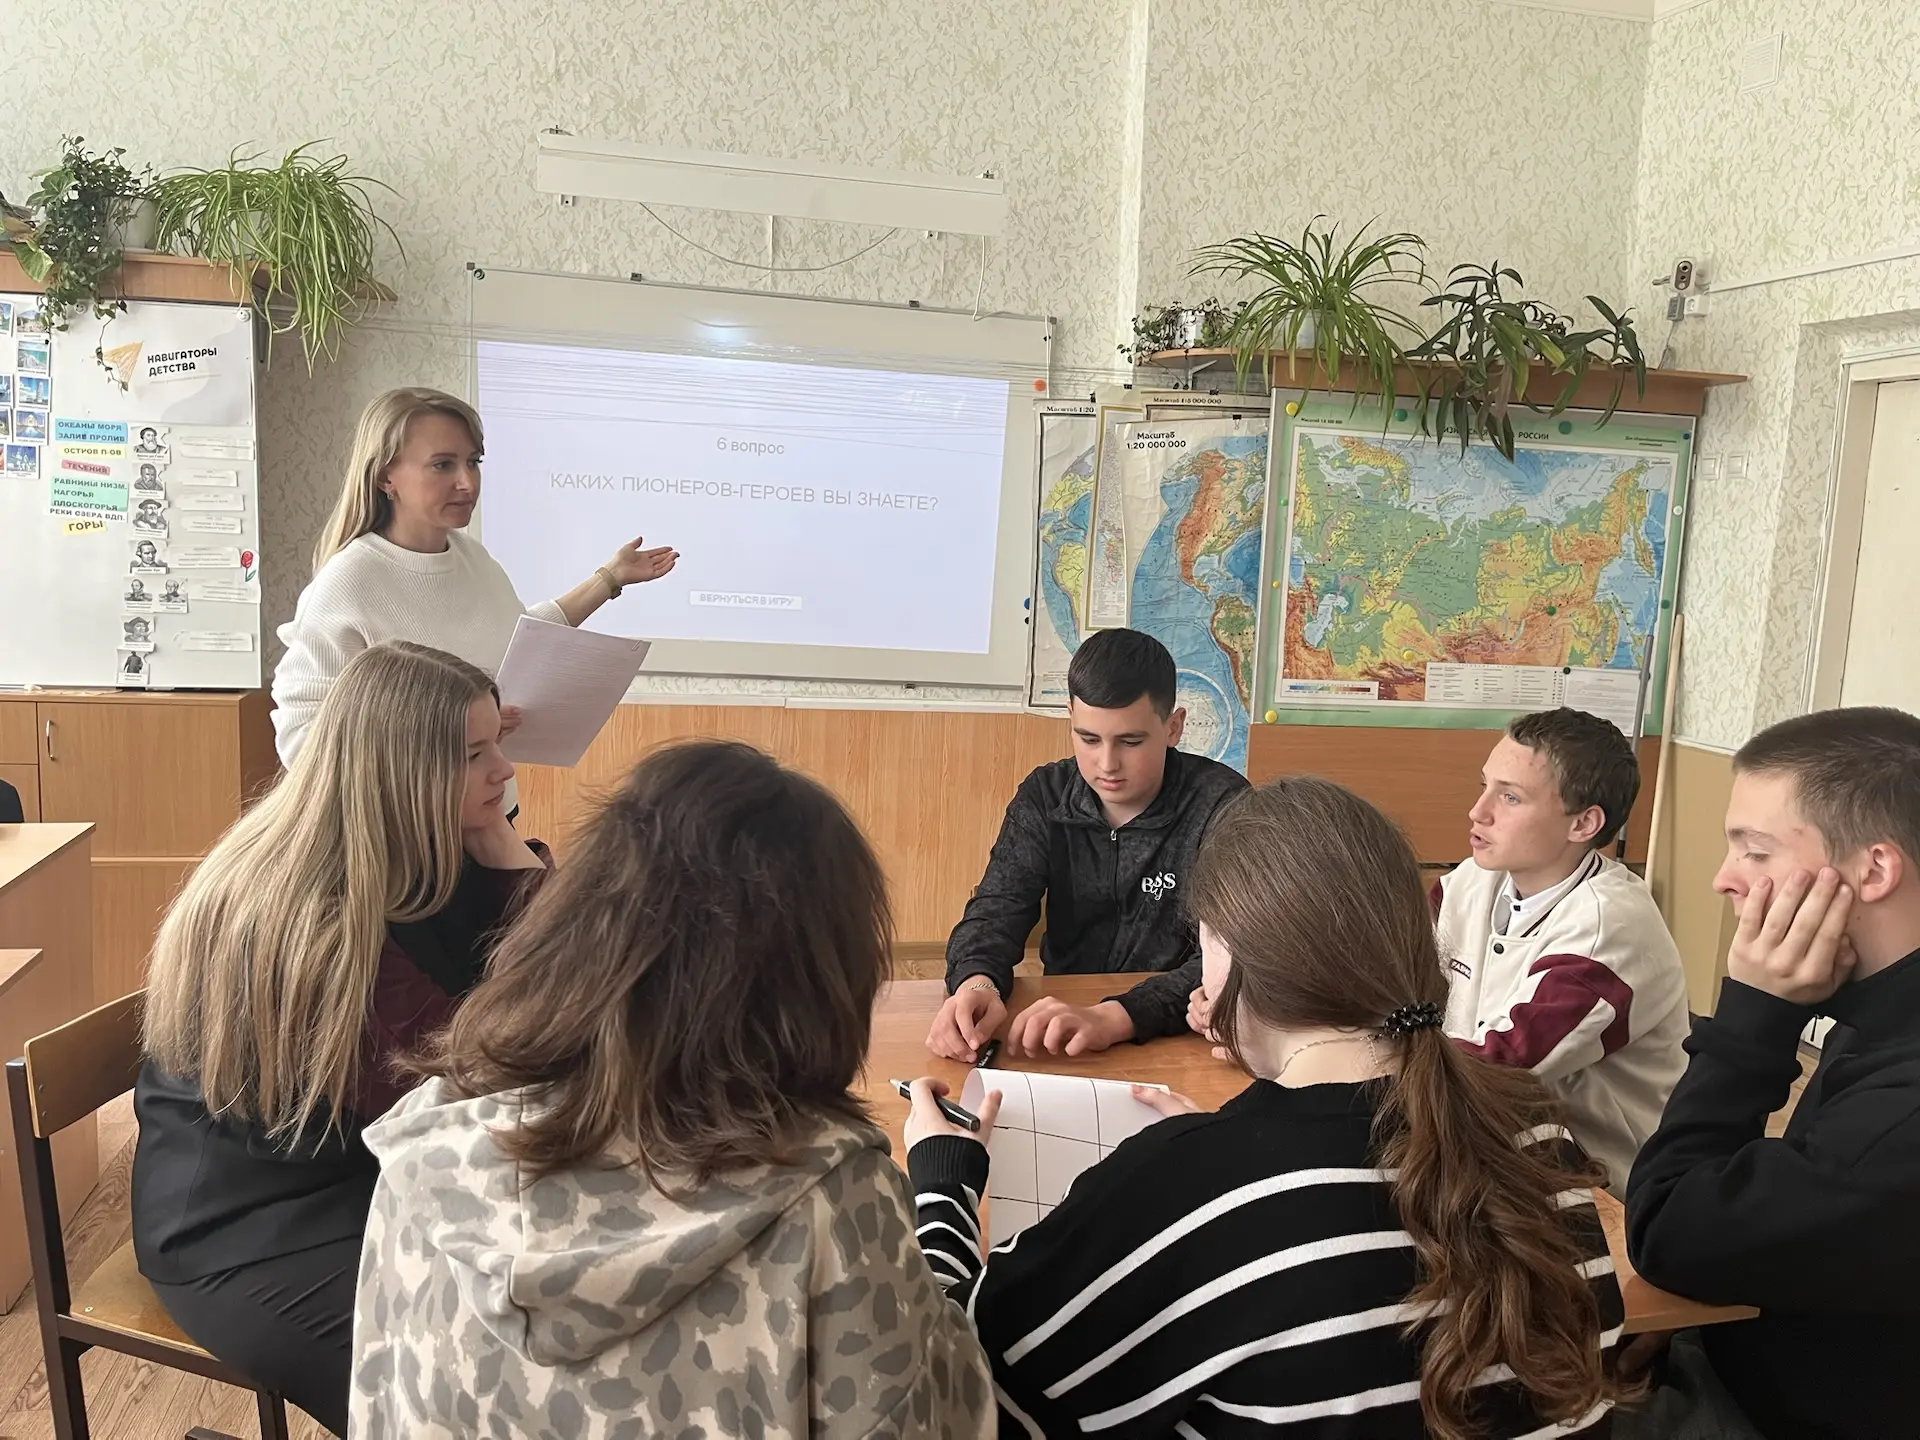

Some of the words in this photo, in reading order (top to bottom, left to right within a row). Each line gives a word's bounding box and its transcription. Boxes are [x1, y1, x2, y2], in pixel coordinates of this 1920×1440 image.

[147, 347, 217, 364] НАВИГАТОРЫ
[148, 362, 196, 377] ДЕТСТВА
[58, 421, 95, 429] ОКЕАНЫ
[97, 423, 122, 431] МОРЯ
[89, 434, 125, 442] ПРОЛИВ
[1137, 431, 1175, 439] Масштаб
[1518, 432, 1549, 440] РОССИИ
[717, 437, 727, 450] 6
[731, 441, 785, 456] вопрос
[1127, 442, 1145, 450] 1:20
[1168, 440, 1186, 448] 000
[64, 447, 98, 455] ОСТРОВ
[67, 462, 108, 474] ТЕЧЕНИЯ
[54, 478, 98, 487] РАВНИНЫ
[53, 489, 94, 498] НАГОРЬЯ
[551, 473, 614, 490] КАКИХ
[622, 476, 815, 503] ПИОНЕРОВ-ГЕРОЕВ
[823, 489, 851, 504] ВЫ
[857, 492, 939, 511] ЗНАЕТЕ?
[53, 500, 118, 511] ПЛОСКОГОРЬЯ
[50, 508, 72, 516] РЕКИ
[74, 511, 103, 519] ОЗЕРА
[68, 520, 103, 531] ГОРЫ
[700, 593, 758, 604] ВЕРНУТЬСЯ
[760, 596, 767, 605] В
[768, 597, 794, 606] ИГРУ
